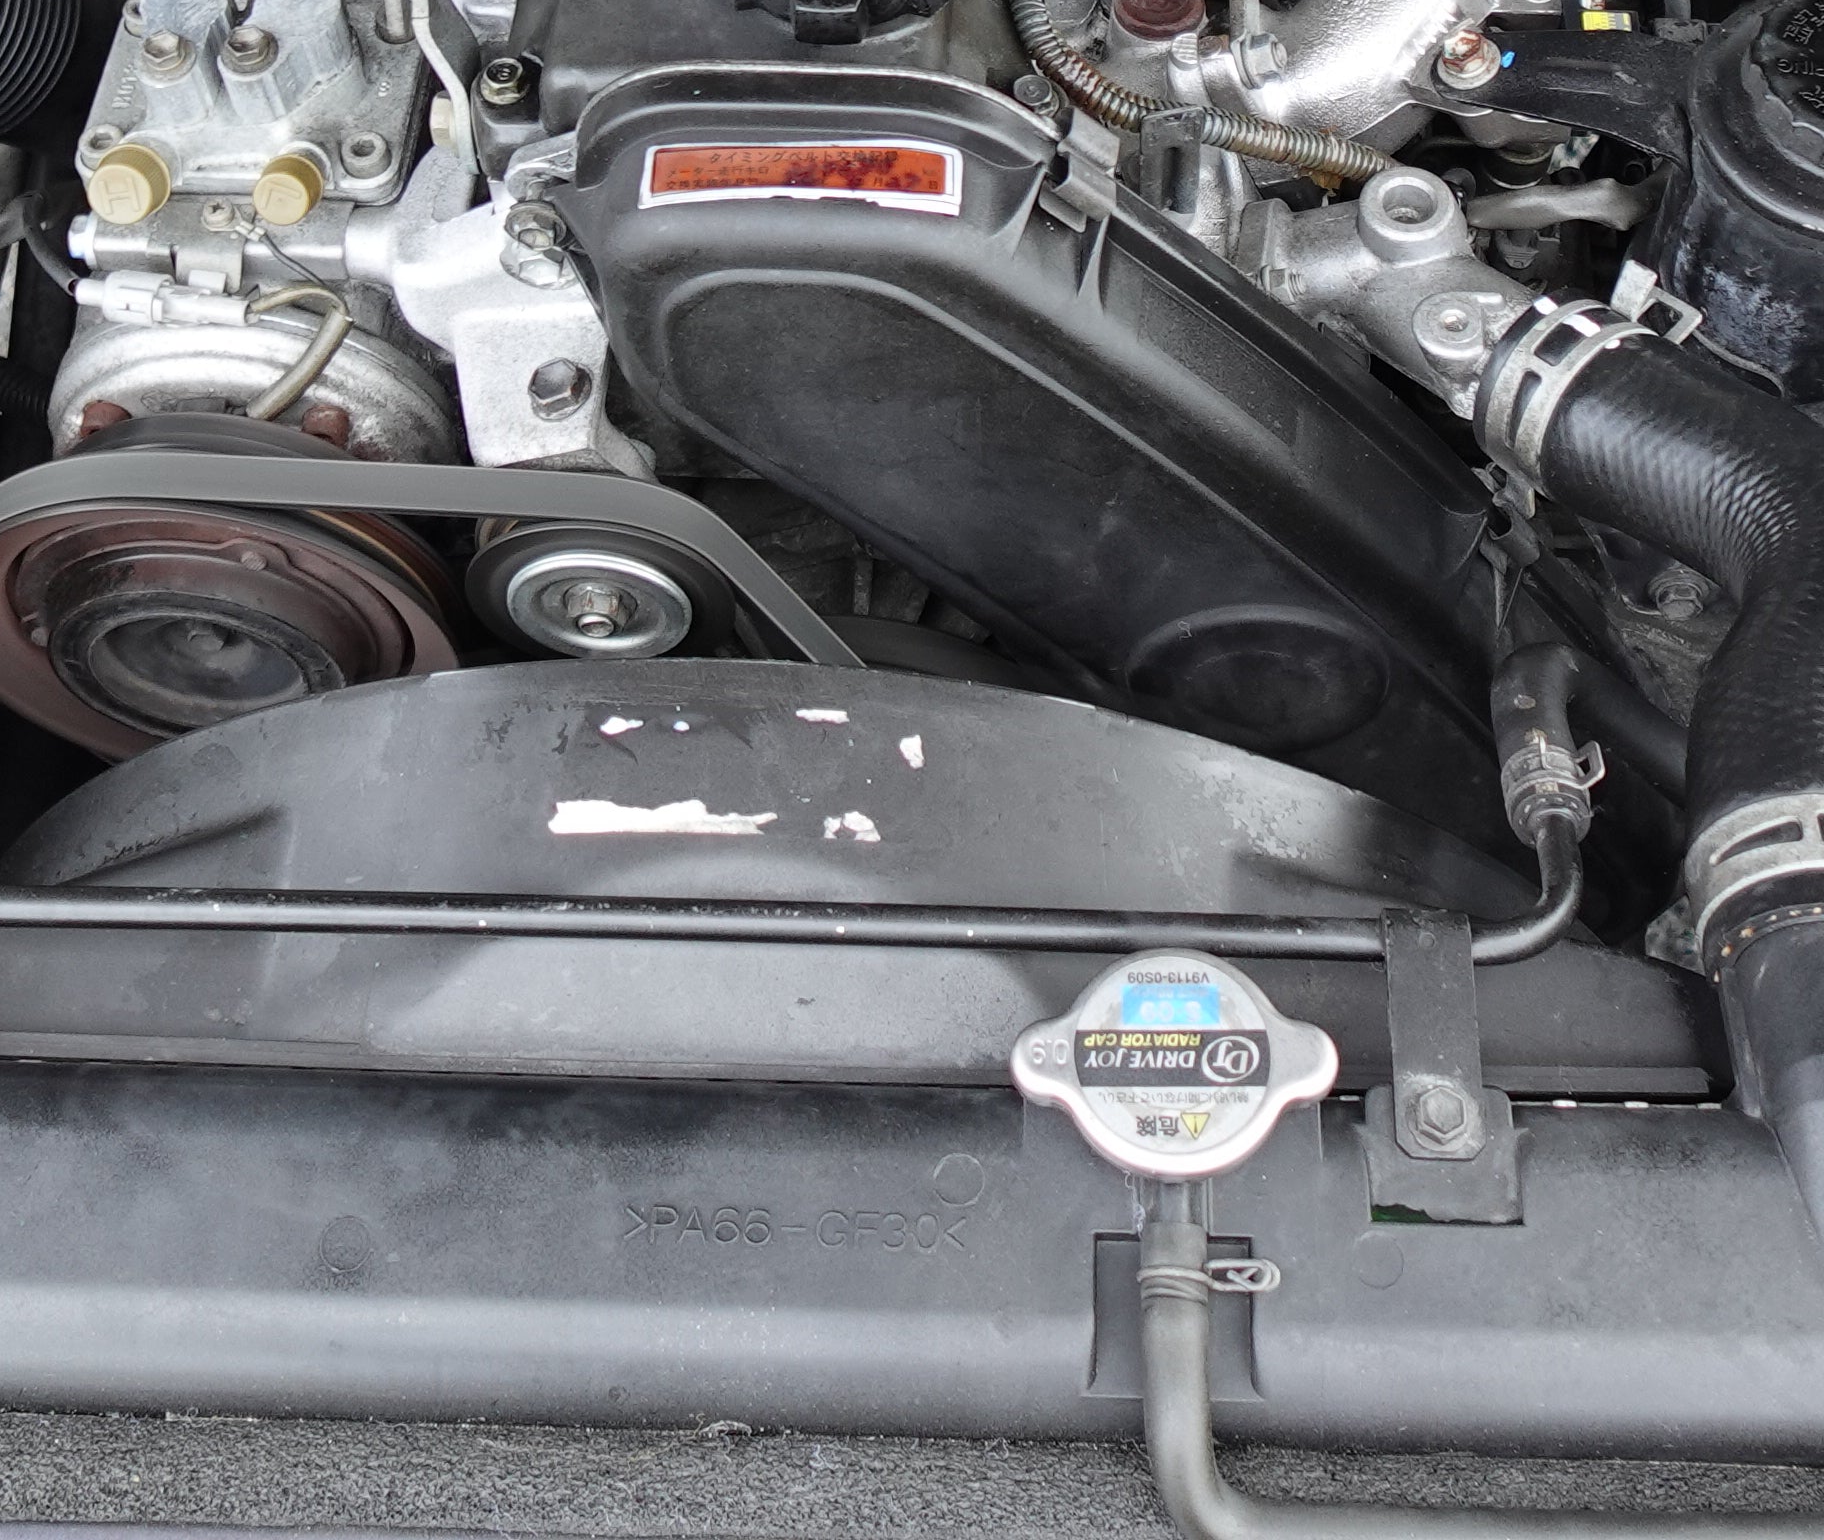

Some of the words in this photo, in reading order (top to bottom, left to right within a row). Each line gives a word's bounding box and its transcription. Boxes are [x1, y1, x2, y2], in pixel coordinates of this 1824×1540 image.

[97, 175, 142, 216] H
[1127, 971, 1211, 984] V9113-0S09
[1084, 1033, 1118, 1047] CAP
[1120, 1033, 1201, 1047] RADIATOR
[1028, 1038, 1071, 1065] 0.9
[1083, 1048, 1128, 1068] JOY
[1128, 1050, 1195, 1069] DRIVE
[1136, 1115, 1180, 1138] 危険
